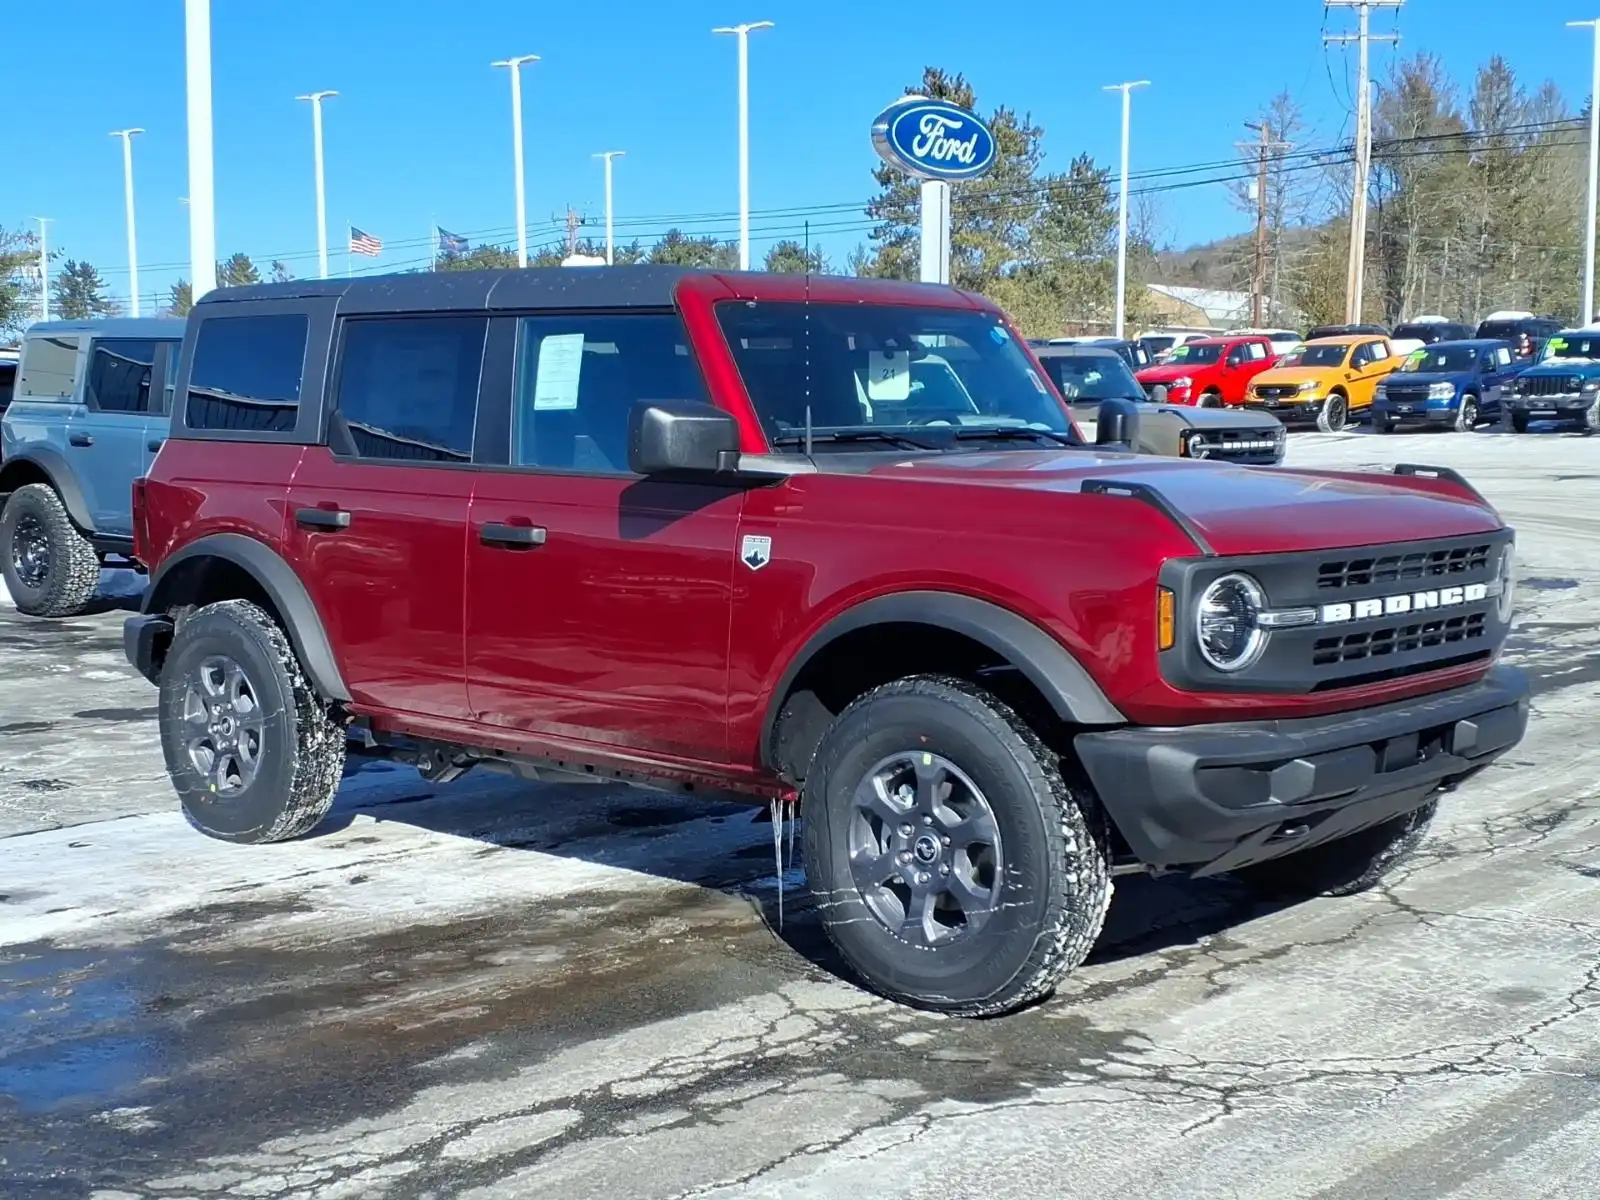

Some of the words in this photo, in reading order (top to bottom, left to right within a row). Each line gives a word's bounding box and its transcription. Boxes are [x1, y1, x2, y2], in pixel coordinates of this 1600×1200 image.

[912, 114, 978, 164] Ford
[882, 368, 896, 380] 21
[1322, 583, 1488, 623] BRONCO
